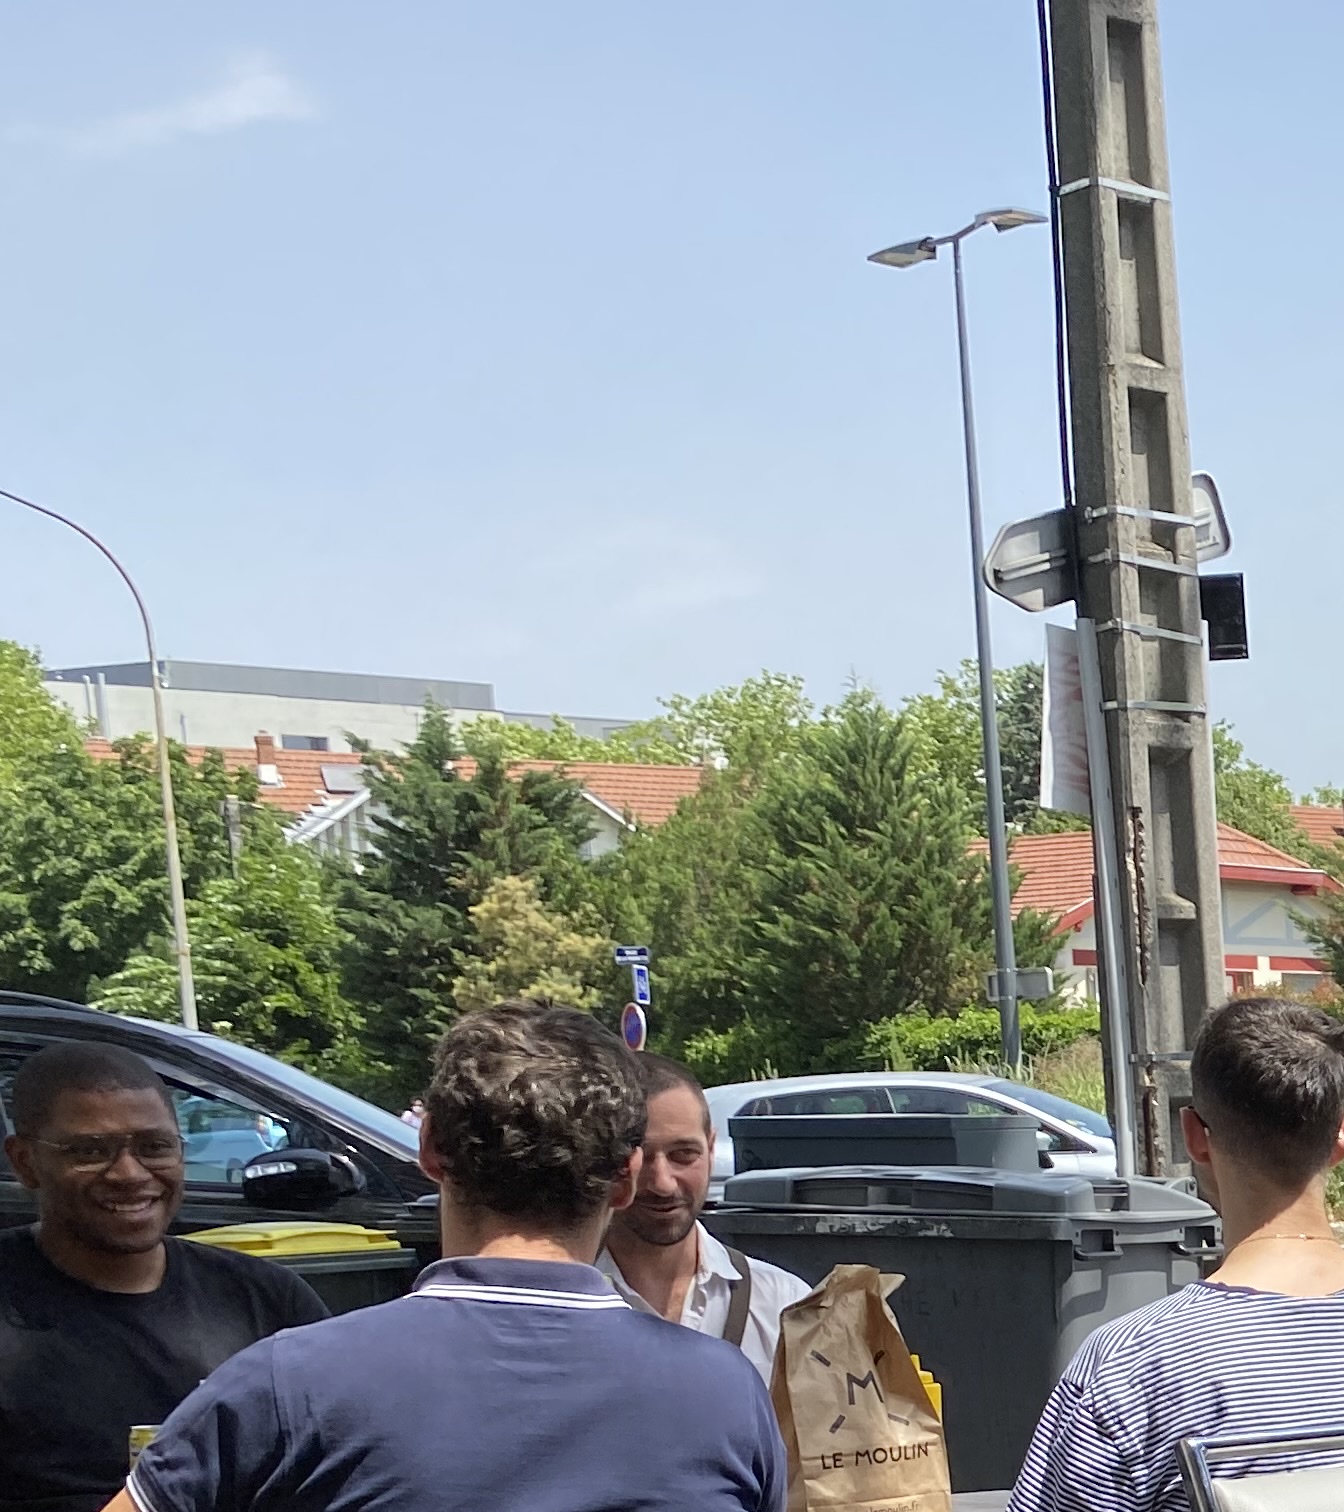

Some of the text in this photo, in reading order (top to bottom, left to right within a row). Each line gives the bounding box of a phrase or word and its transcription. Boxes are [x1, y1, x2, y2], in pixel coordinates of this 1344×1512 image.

[846, 1370, 884, 1405] M
[821, 1442, 929, 1470] LE MOULIN
